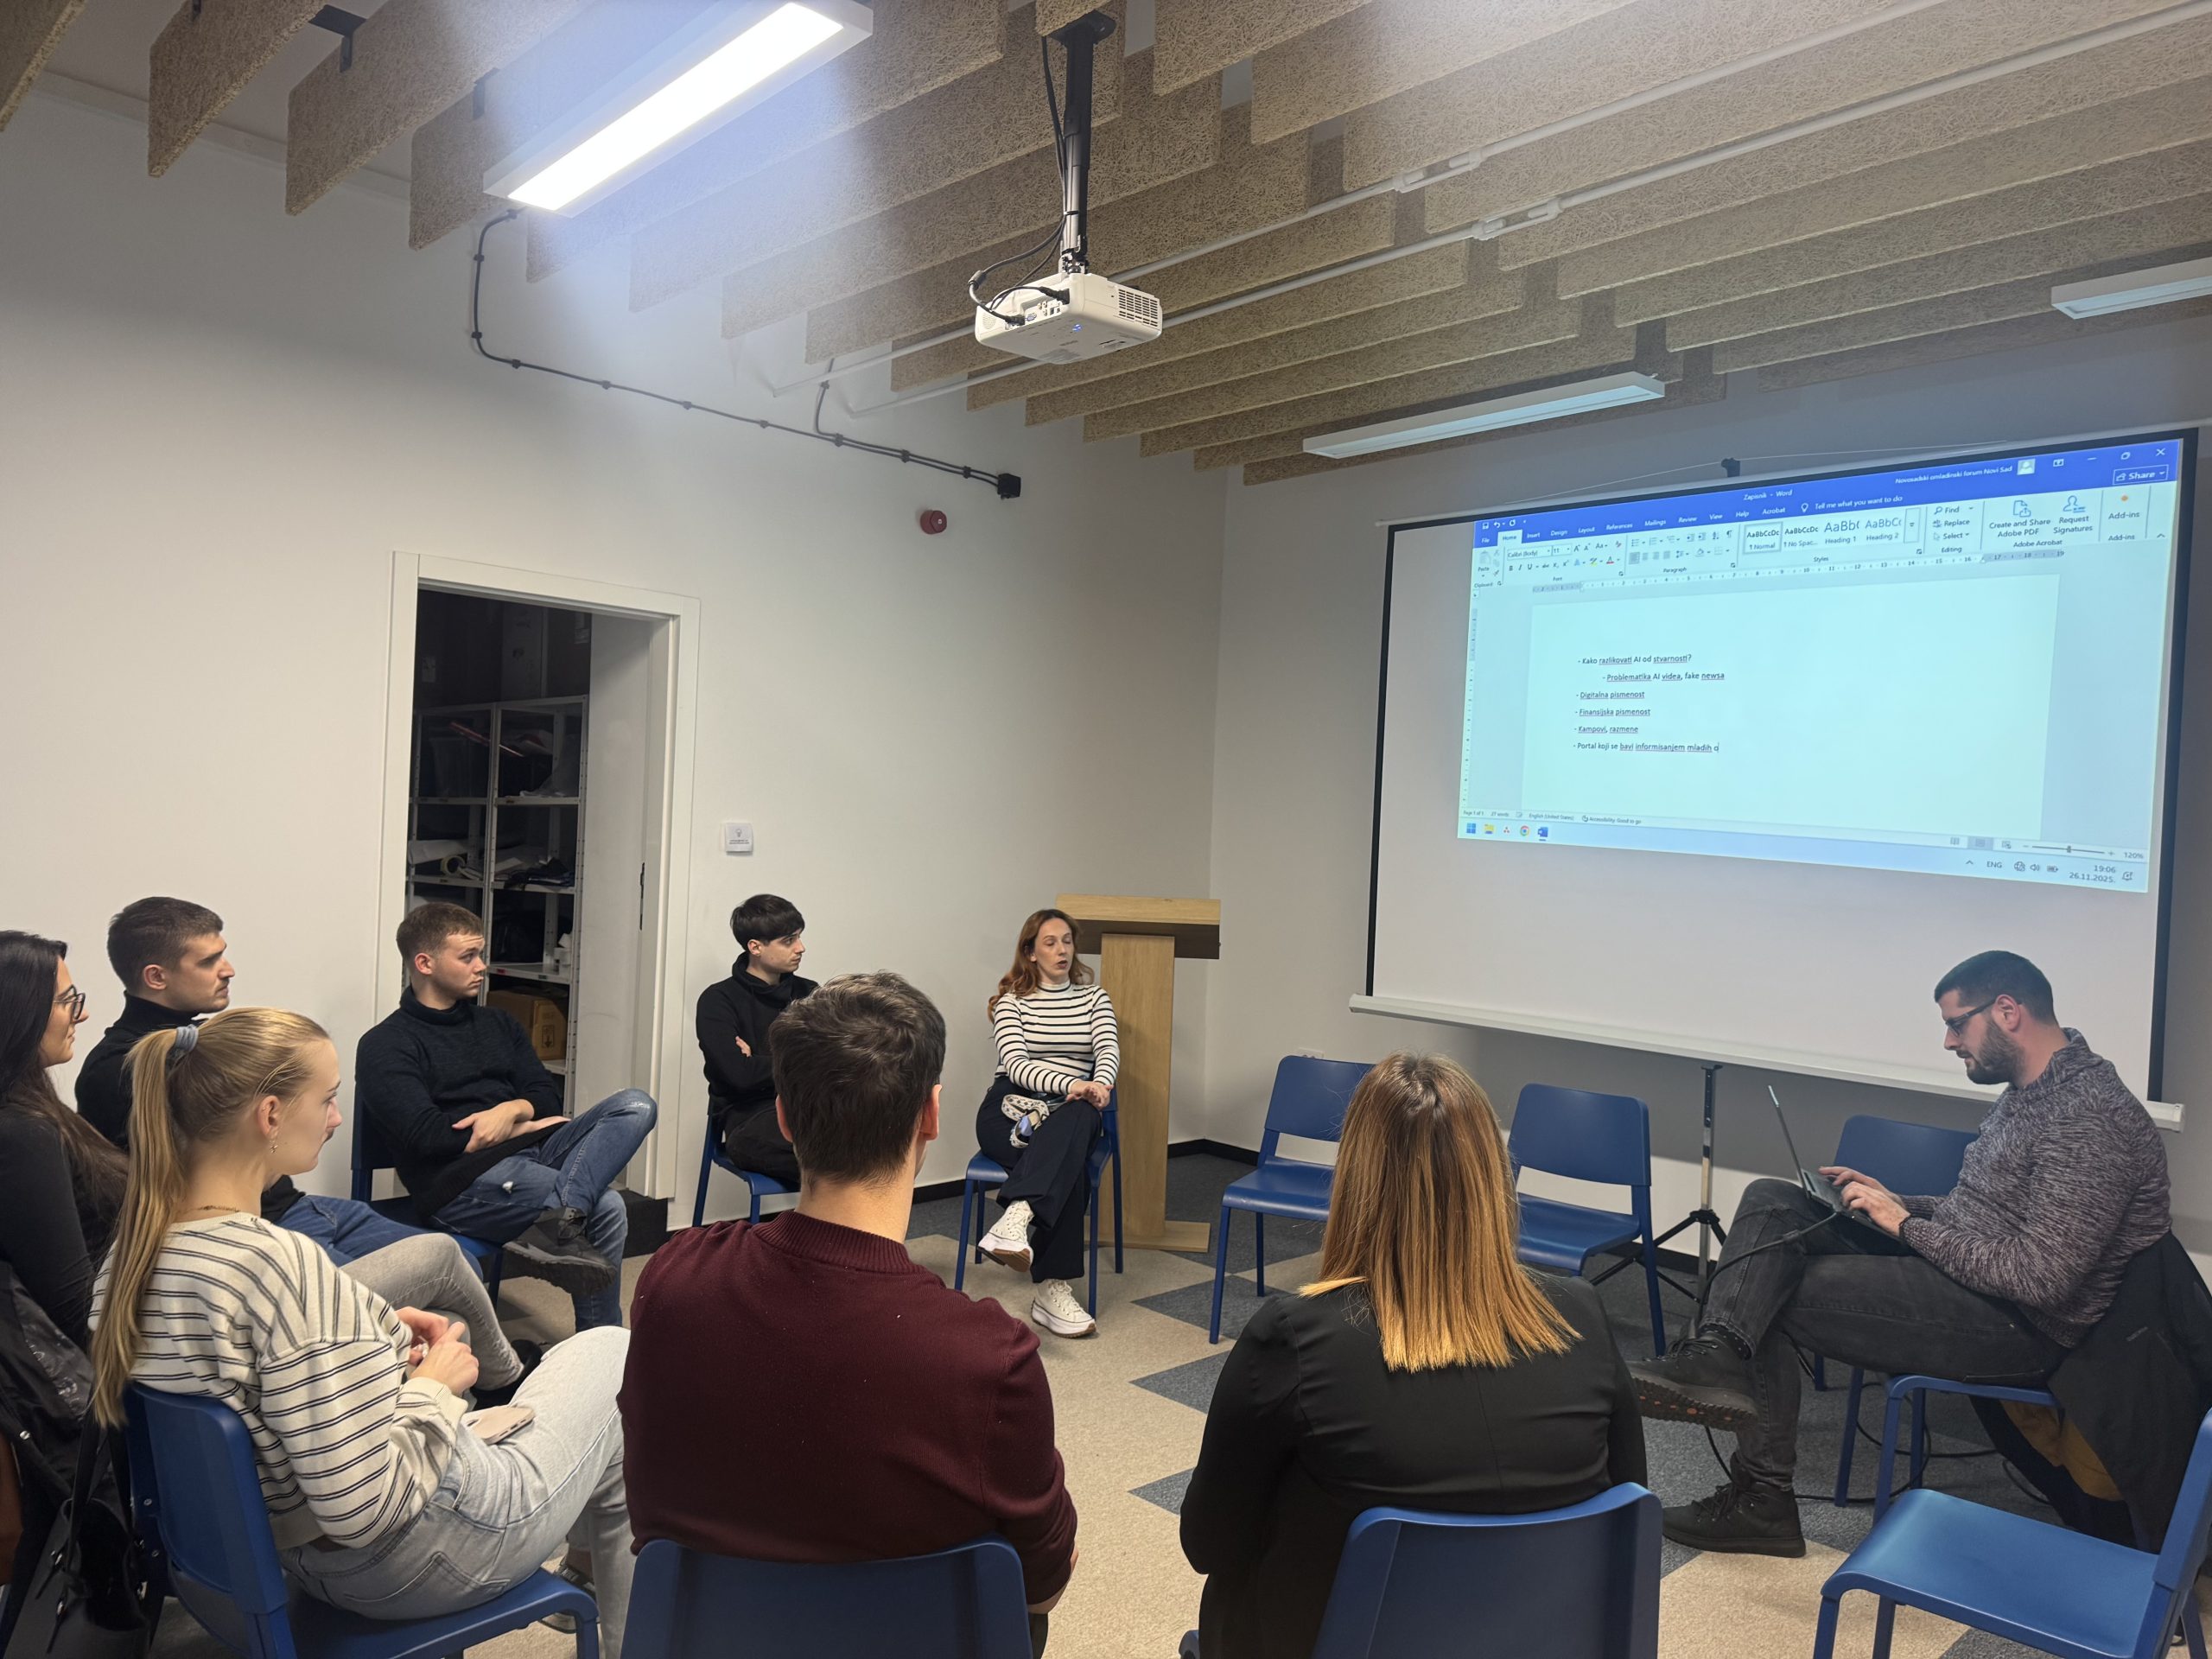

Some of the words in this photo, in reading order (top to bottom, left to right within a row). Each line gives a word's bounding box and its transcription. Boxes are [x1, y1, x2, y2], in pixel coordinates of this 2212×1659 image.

[1929, 472, 1962, 480] omladinski
[2128, 470, 2155, 480] Share
[1744, 492, 1767, 500] Zapisnik
[2059, 516, 2089, 525] Request
[2108, 512, 2140, 520] Add-ins
[1746, 530, 1779, 538] AaBbCcDc
[1784, 525, 1818, 535] AaBbCcDc
[2053, 525, 2093, 535] Signatures
[1653, 654, 1692, 663] stvarnosti?
[1598, 742, 1609, 751] koji
[1636, 743, 1685, 752] informisanjem
[2069, 872, 2116, 883] 26.11.2025.
